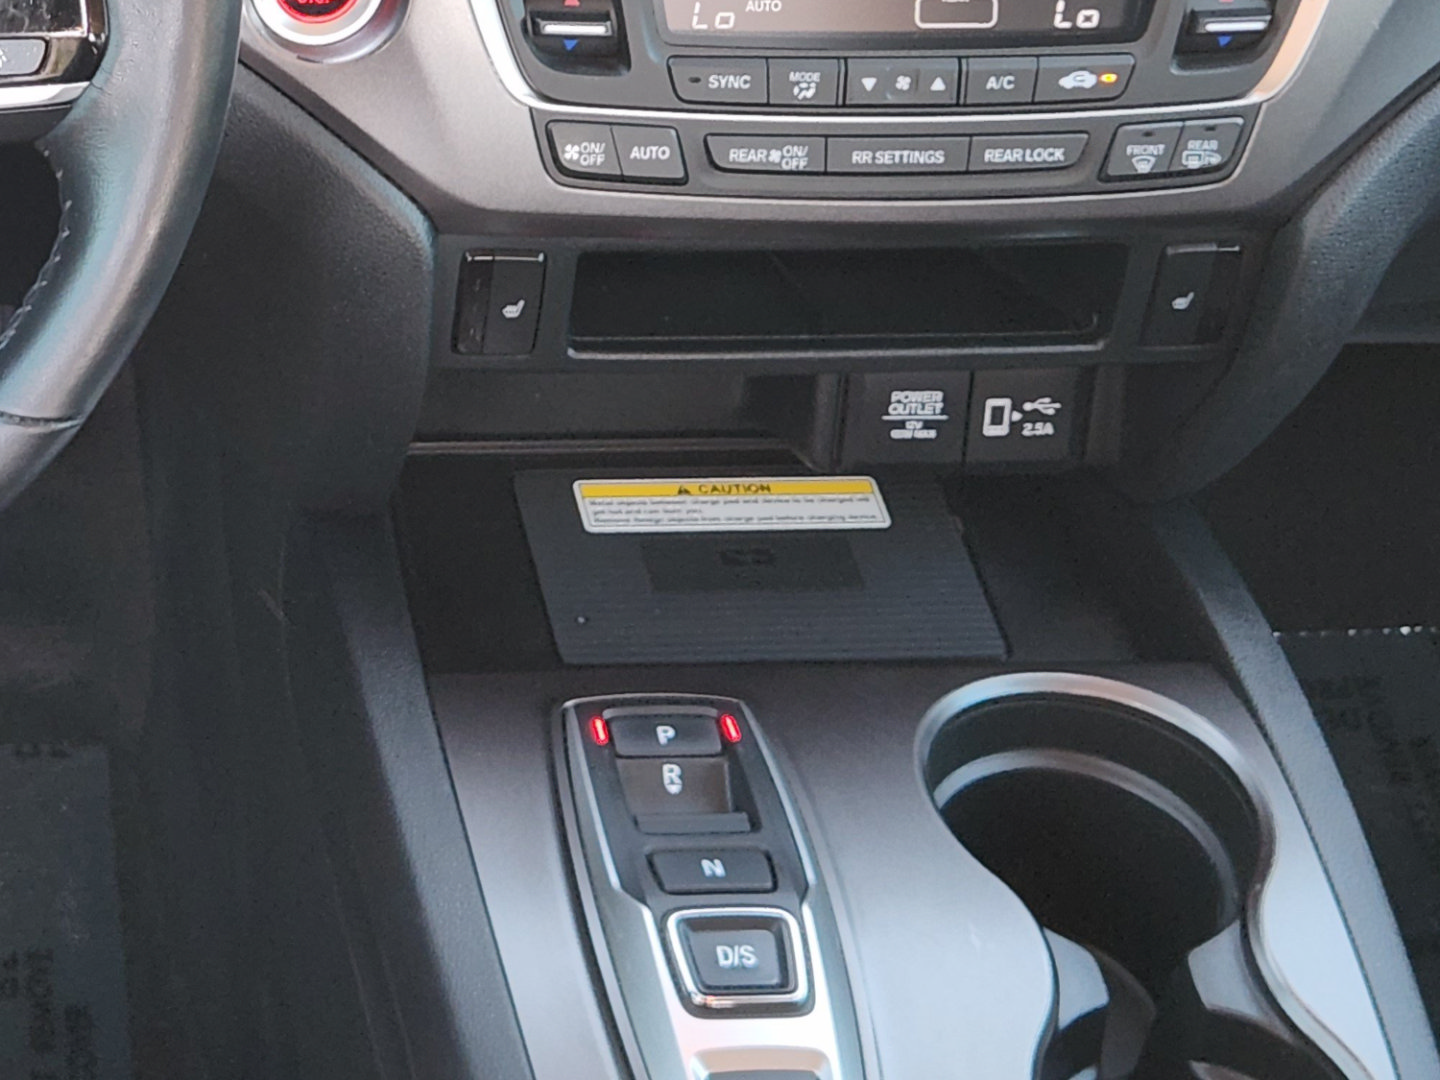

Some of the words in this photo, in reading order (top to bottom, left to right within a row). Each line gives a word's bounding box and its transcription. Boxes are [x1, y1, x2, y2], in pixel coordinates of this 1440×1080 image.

[745, 0, 782, 12] AUTO
[708, 74, 751, 89] SYNC
[789, 72, 821, 82] MODE
[986, 75, 1015, 90] A/C
[1126, 144, 1165, 156] FRONT
[1187, 140, 1218, 151] REAR
[630, 146, 670, 160] AUTO
[729, 148, 767, 162] REAR
[852, 150, 873, 165] RR
[875, 150, 944, 166] SETTINGS
[984, 148, 1024, 164] REAR
[1026, 147, 1065, 163] LOCK
[580, 154, 605, 166] OFF
[781, 157, 808, 170] OFF
[891, 390, 944, 403] POWER
[888, 403, 944, 416] OUTLET
[698, 483, 771, 495] CAUTION
[656, 725, 675, 746] P
[701, 858, 726, 878] N
[716, 945, 757, 968] D/S
